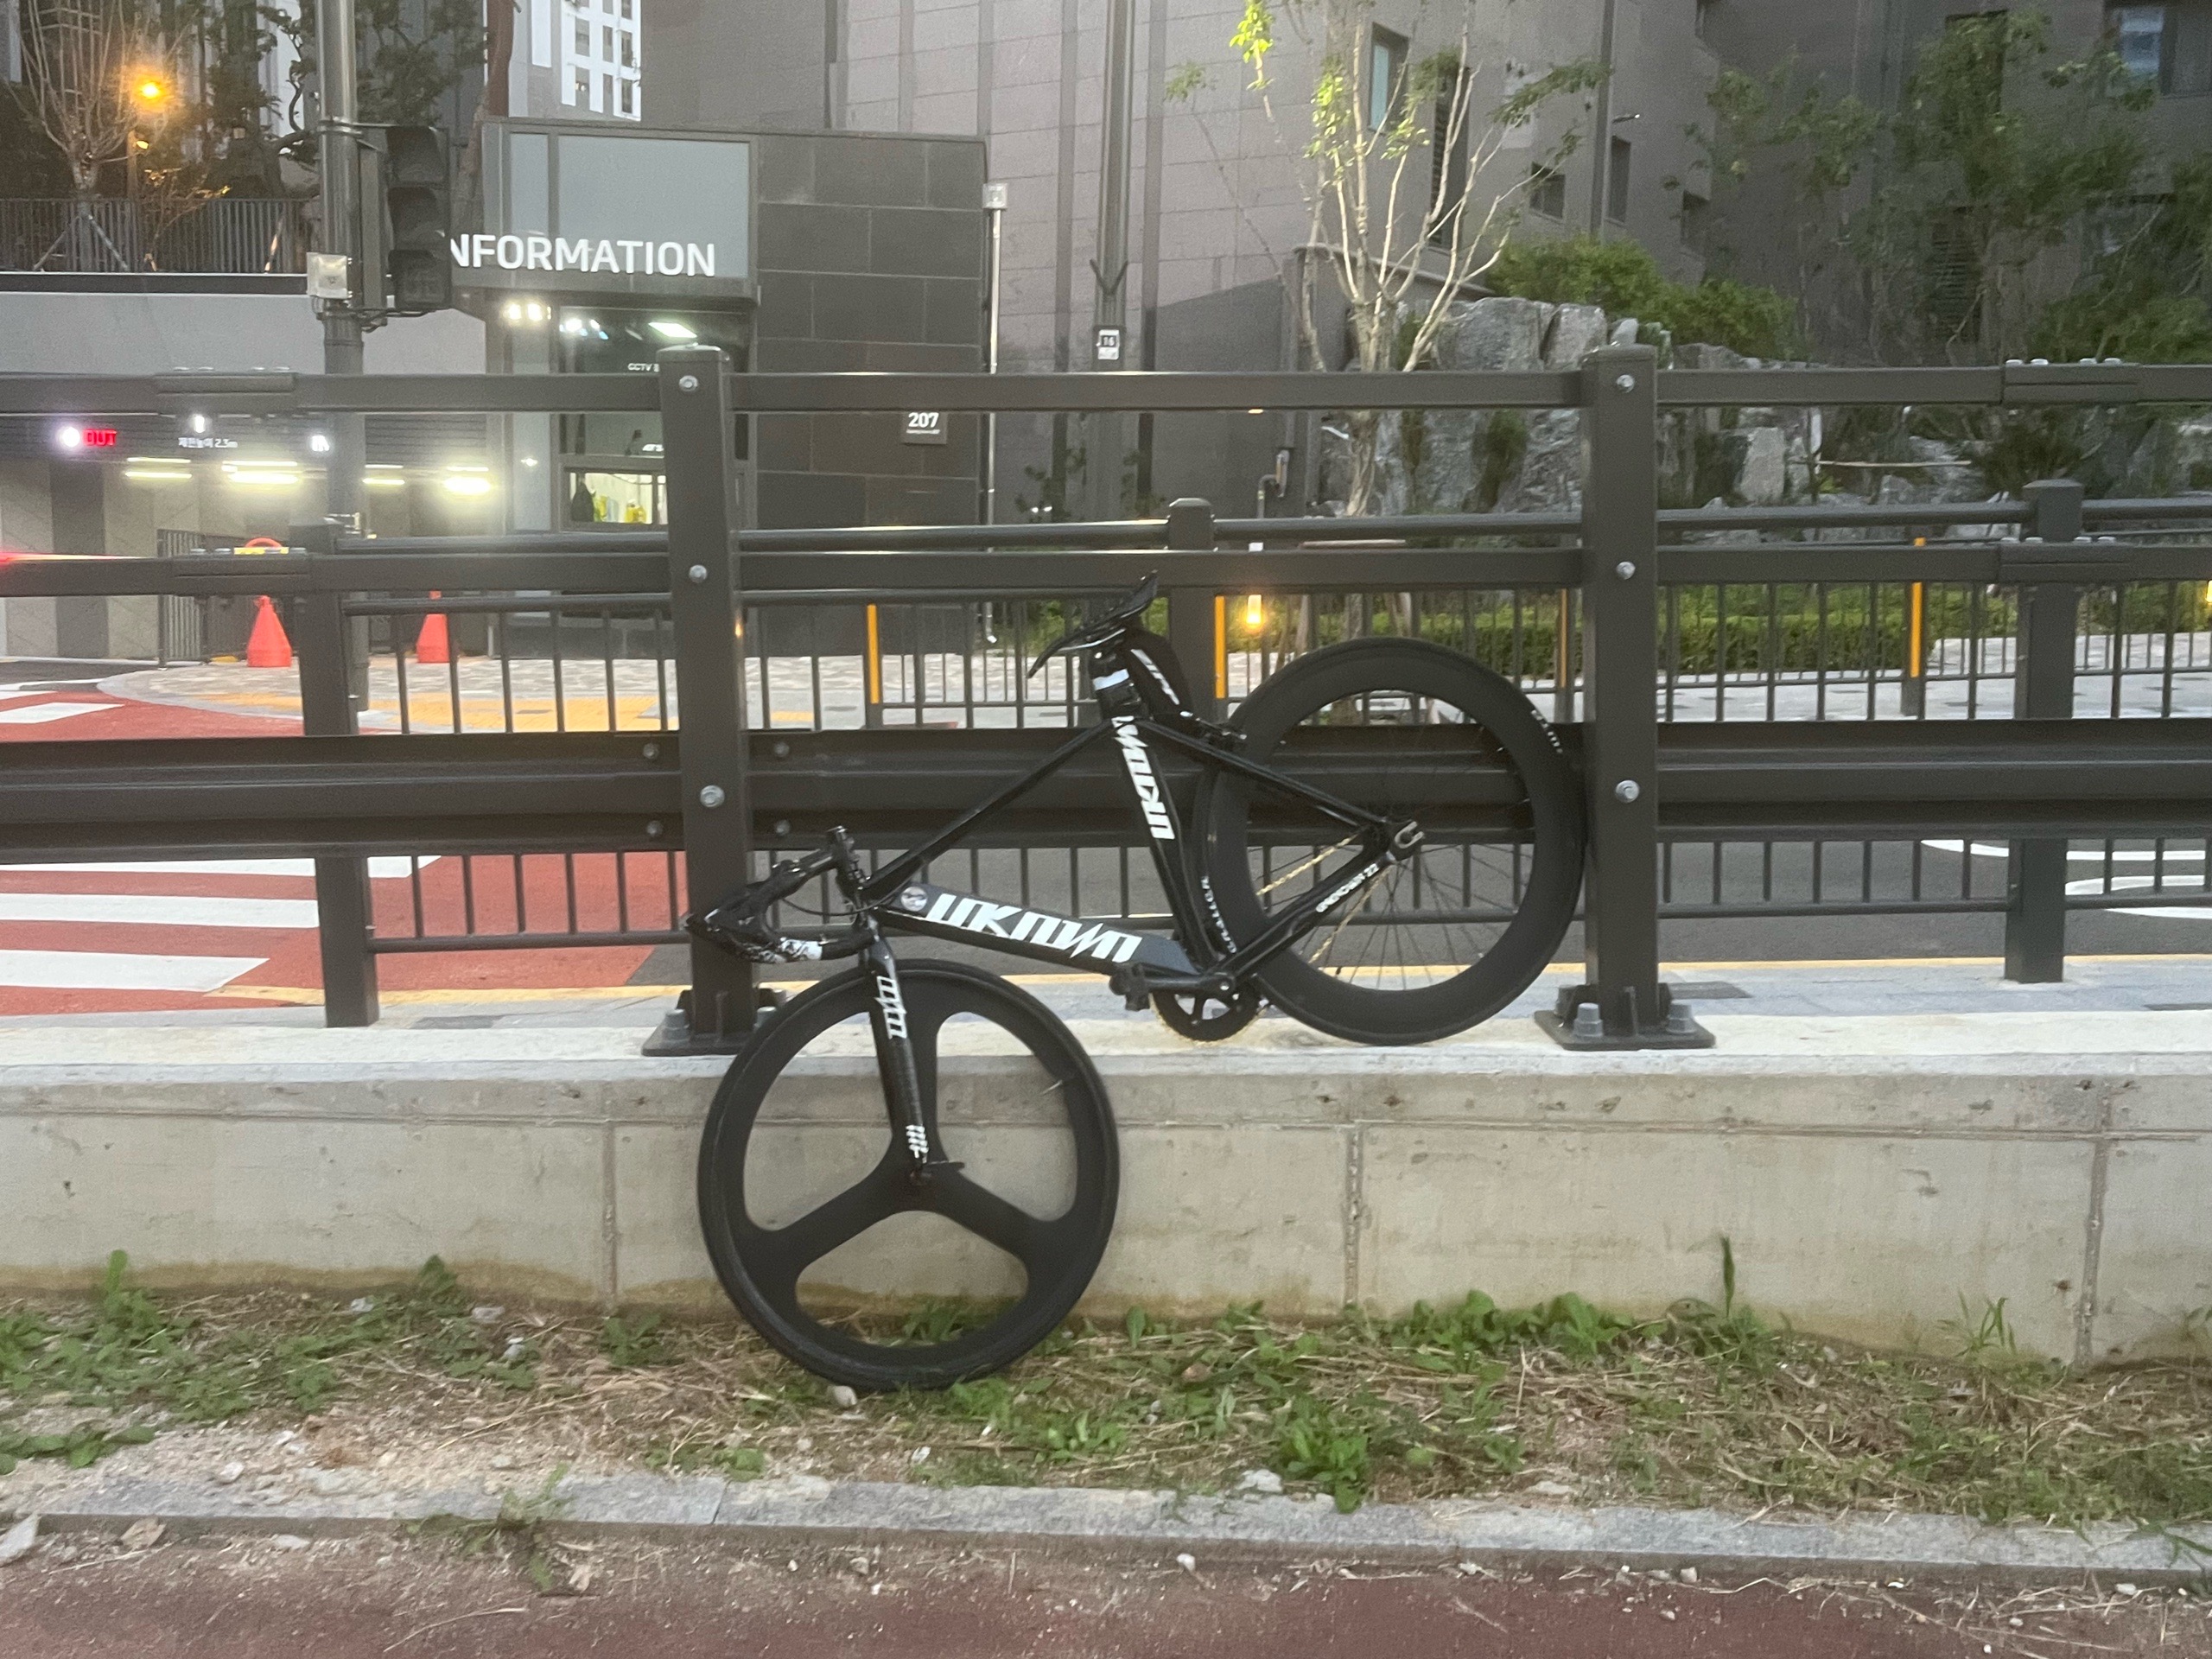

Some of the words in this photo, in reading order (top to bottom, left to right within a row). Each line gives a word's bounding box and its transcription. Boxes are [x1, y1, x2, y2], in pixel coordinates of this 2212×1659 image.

[450, 233, 715, 276] NFORMATION
[627, 363, 653, 372] CCTV
[908, 411, 939, 428] 207
[83, 429, 118, 447] OUT
